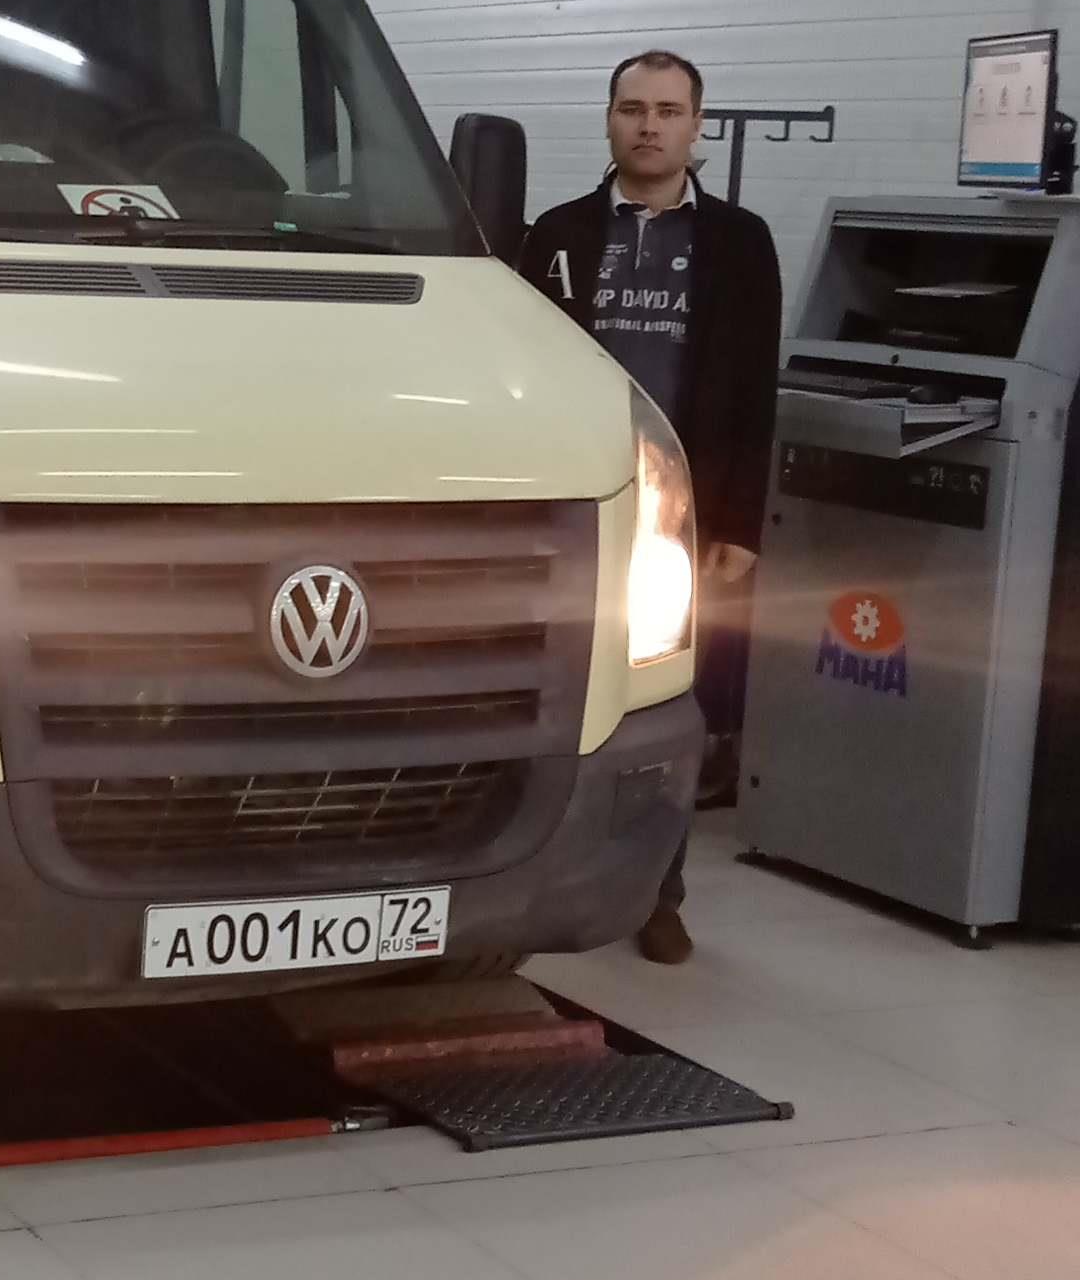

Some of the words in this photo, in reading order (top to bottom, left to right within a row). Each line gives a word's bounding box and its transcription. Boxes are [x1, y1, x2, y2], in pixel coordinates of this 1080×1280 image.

[621, 289, 669, 310] DAVID
[388, 897, 432, 937] 72
[380, 937, 414, 954] RUS
